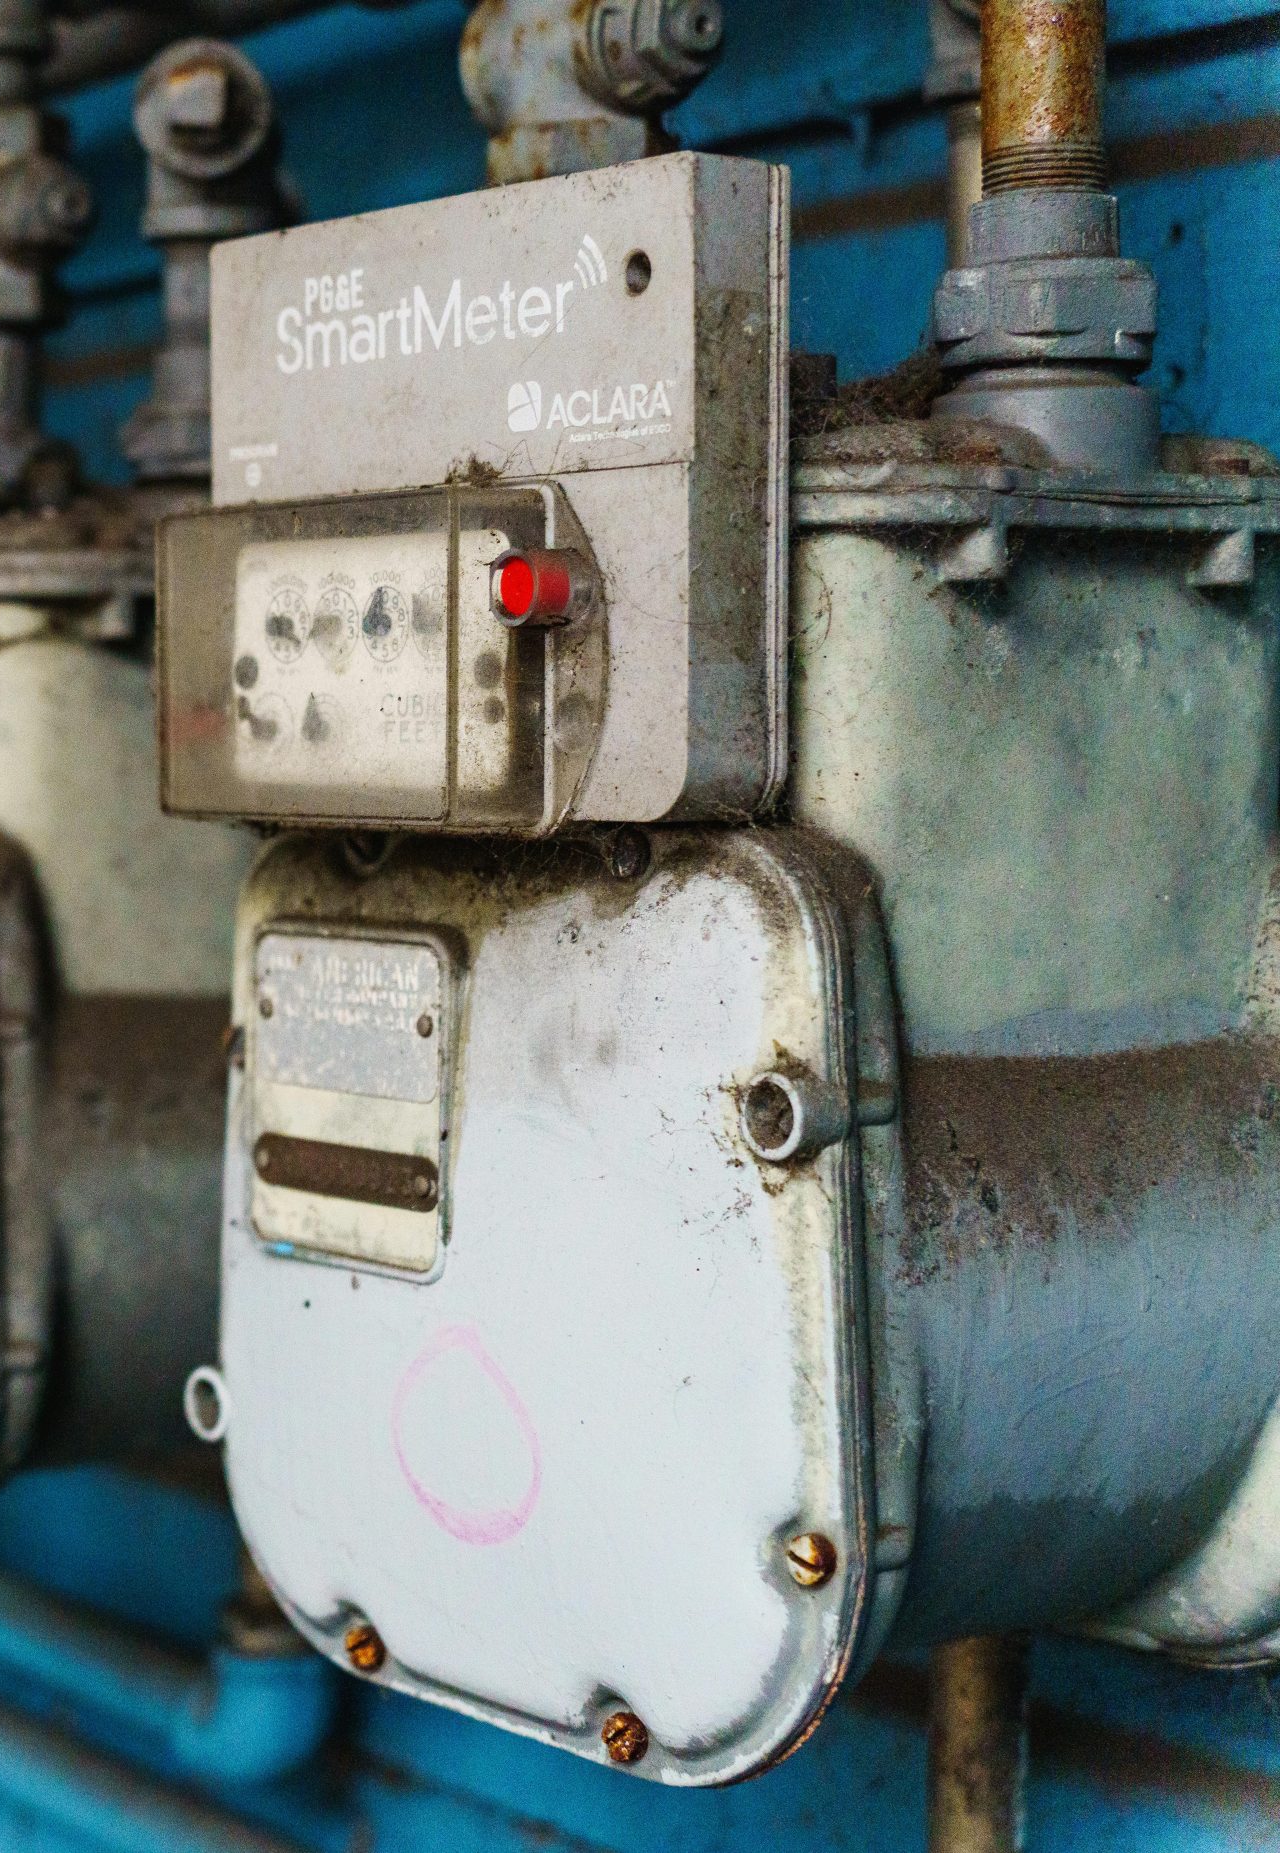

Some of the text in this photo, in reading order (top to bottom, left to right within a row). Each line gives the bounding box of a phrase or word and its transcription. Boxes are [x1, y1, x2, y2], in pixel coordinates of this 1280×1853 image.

[305, 268, 365, 316] PG&E
[276, 278, 574, 374] SmartMeter
[546, 380, 672, 430] ACLARA
